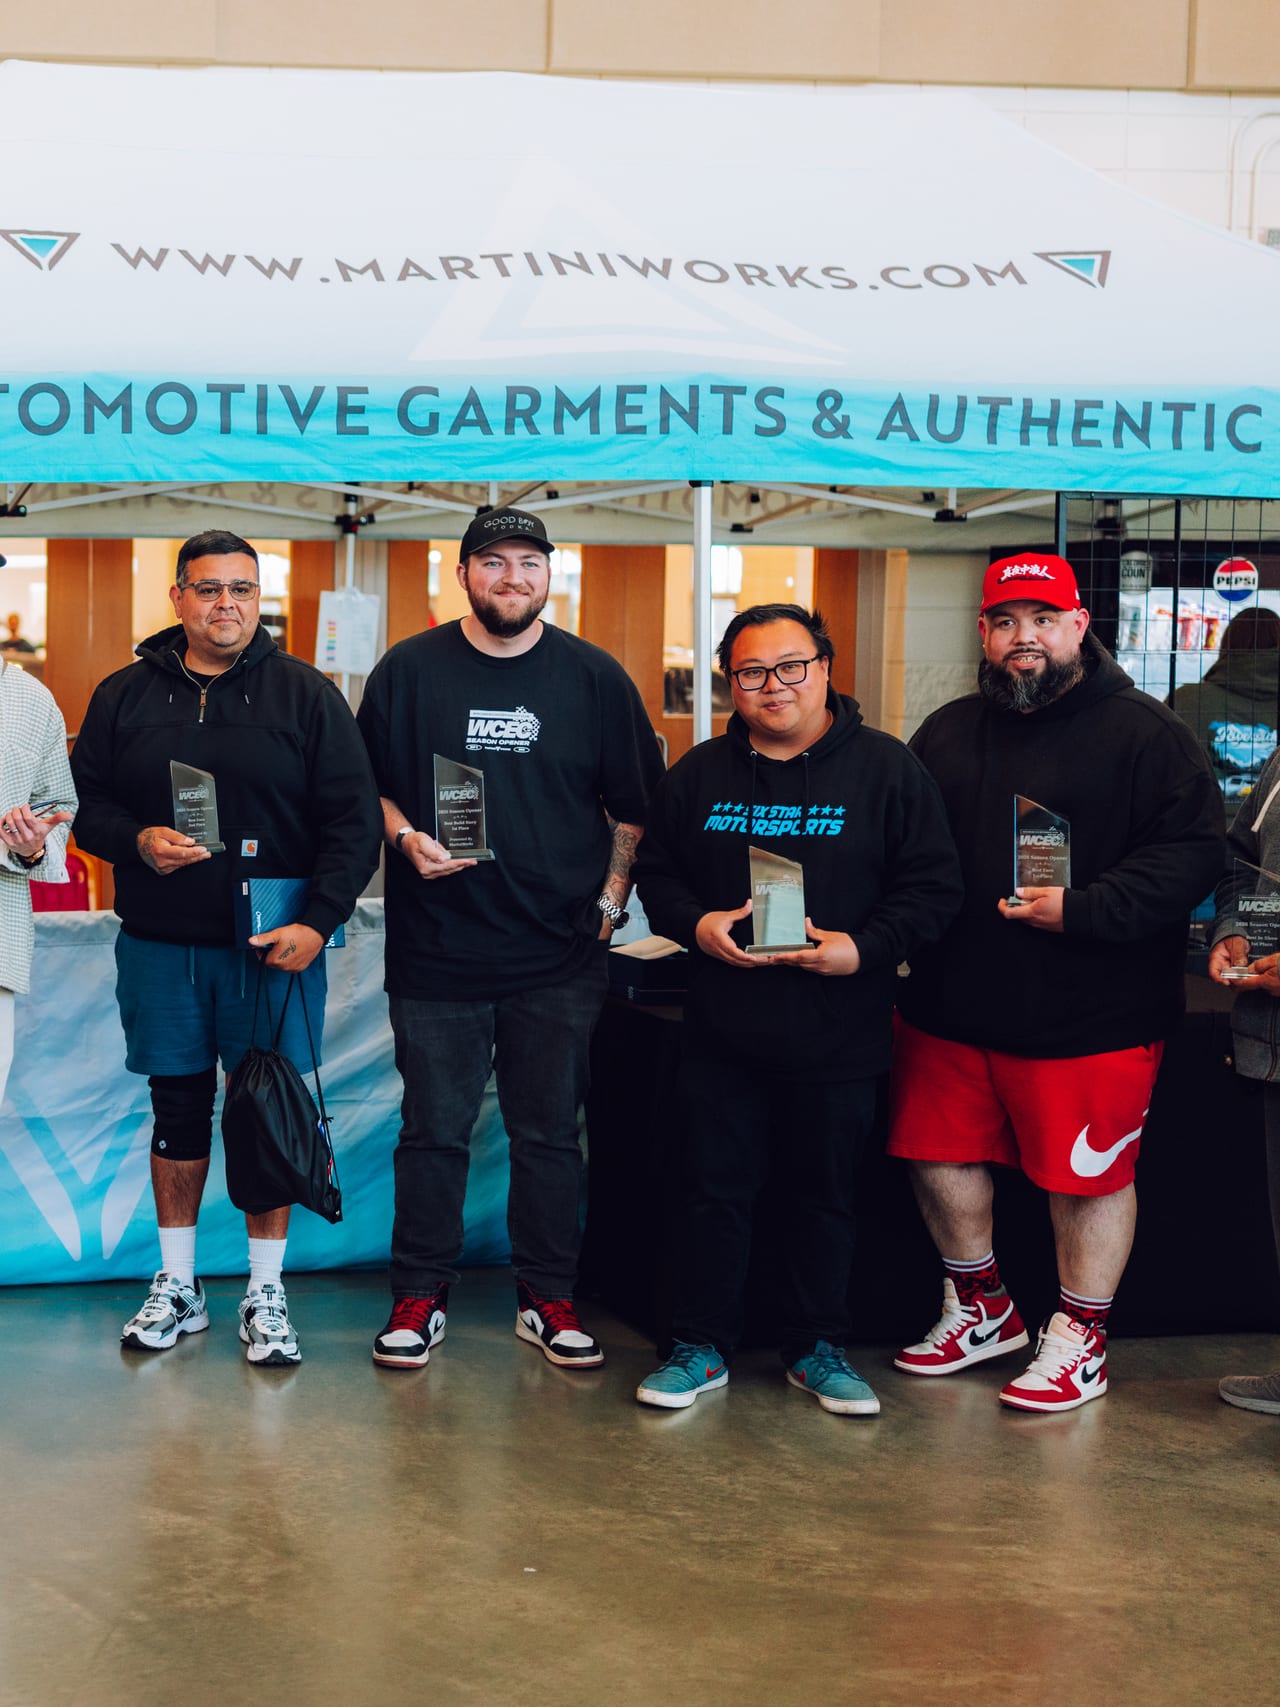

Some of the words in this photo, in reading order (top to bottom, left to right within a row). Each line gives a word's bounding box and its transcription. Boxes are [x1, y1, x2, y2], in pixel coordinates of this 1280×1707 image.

[110, 242, 1029, 291] WWW.MARTINIWORKS.COM
[397, 384, 787, 438] GARMENTS
[812, 388, 852, 440] &
[877, 392, 1263, 453] AUTHENTIC
[484, 516, 516, 528] GOOD
[1216, 575, 1256, 586] PEPSI
[467, 718, 533, 740] WCEC
[466, 737, 498, 745] SEASON
[179, 789, 207, 801] WCEC
[439, 789, 476, 801] WCEC
[704, 815, 845, 837] MOTORSPORTS
[1020, 834, 1058, 846] WCEC
